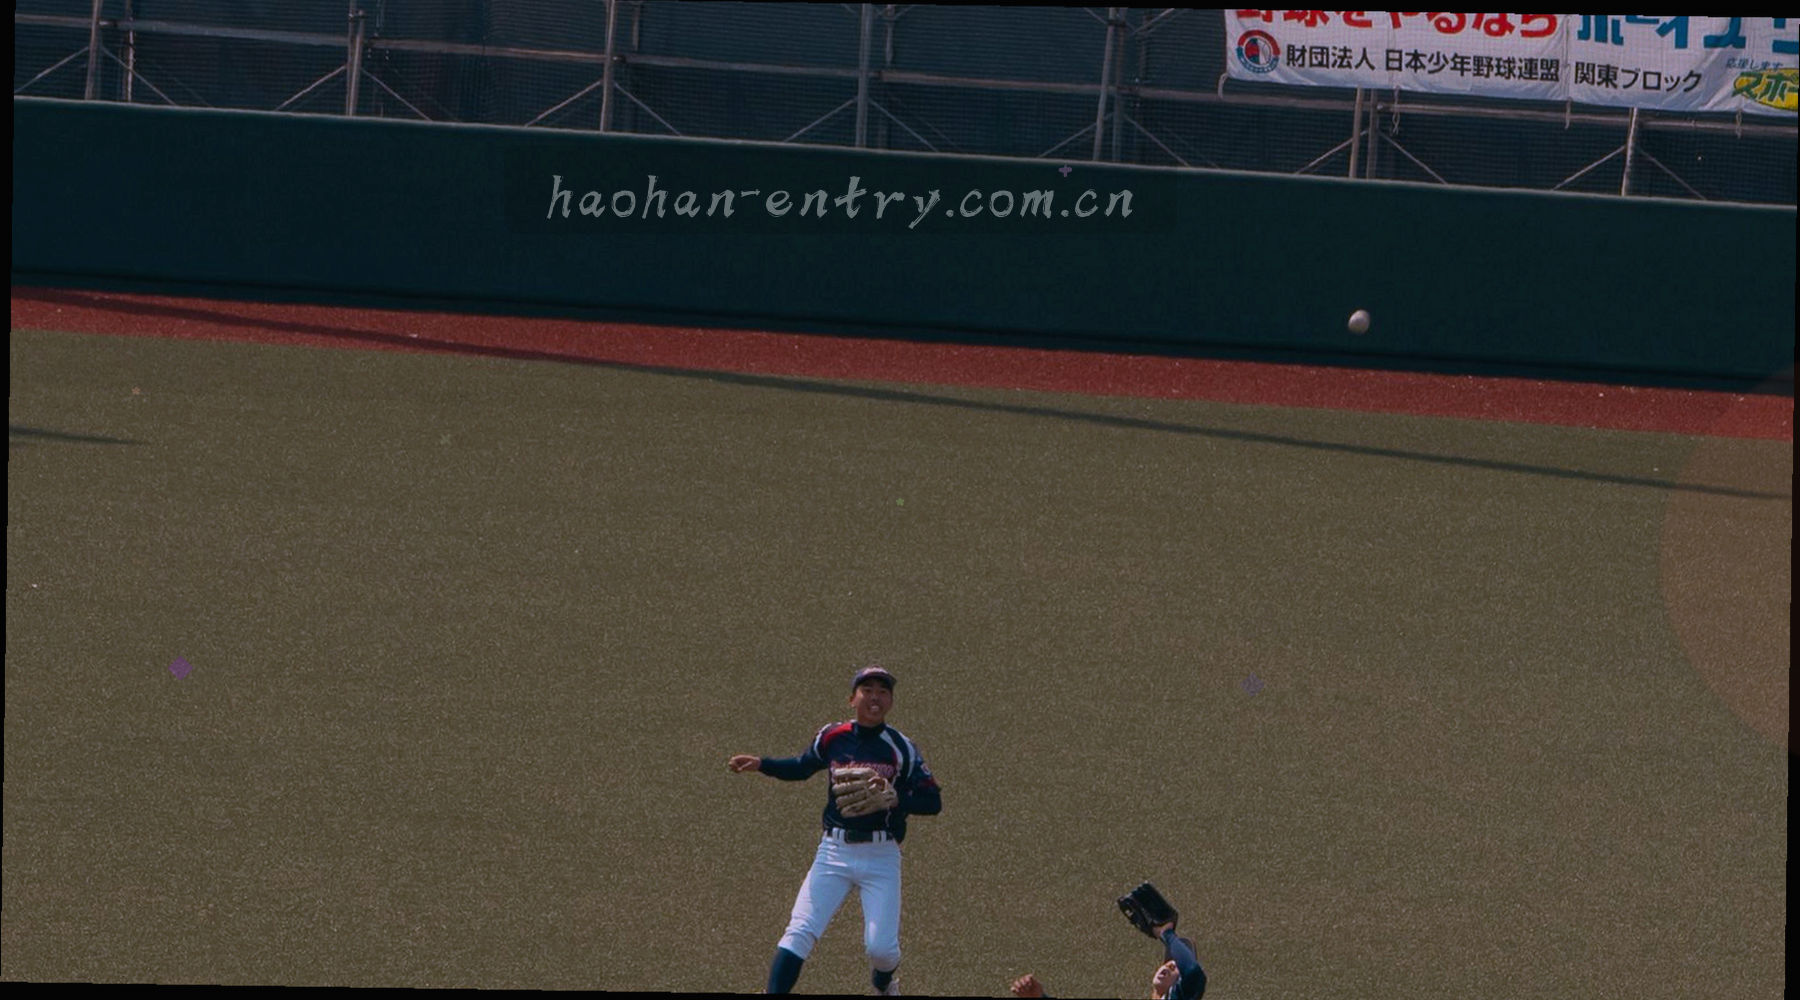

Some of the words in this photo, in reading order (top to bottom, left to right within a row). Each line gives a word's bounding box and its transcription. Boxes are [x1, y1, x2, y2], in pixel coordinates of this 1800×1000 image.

[1286, 44, 1375, 71] 財団法人
[1385, 49, 1560, 82] 日本少年野球連盟
[1574, 61, 1703, 93] 関東ブロック
